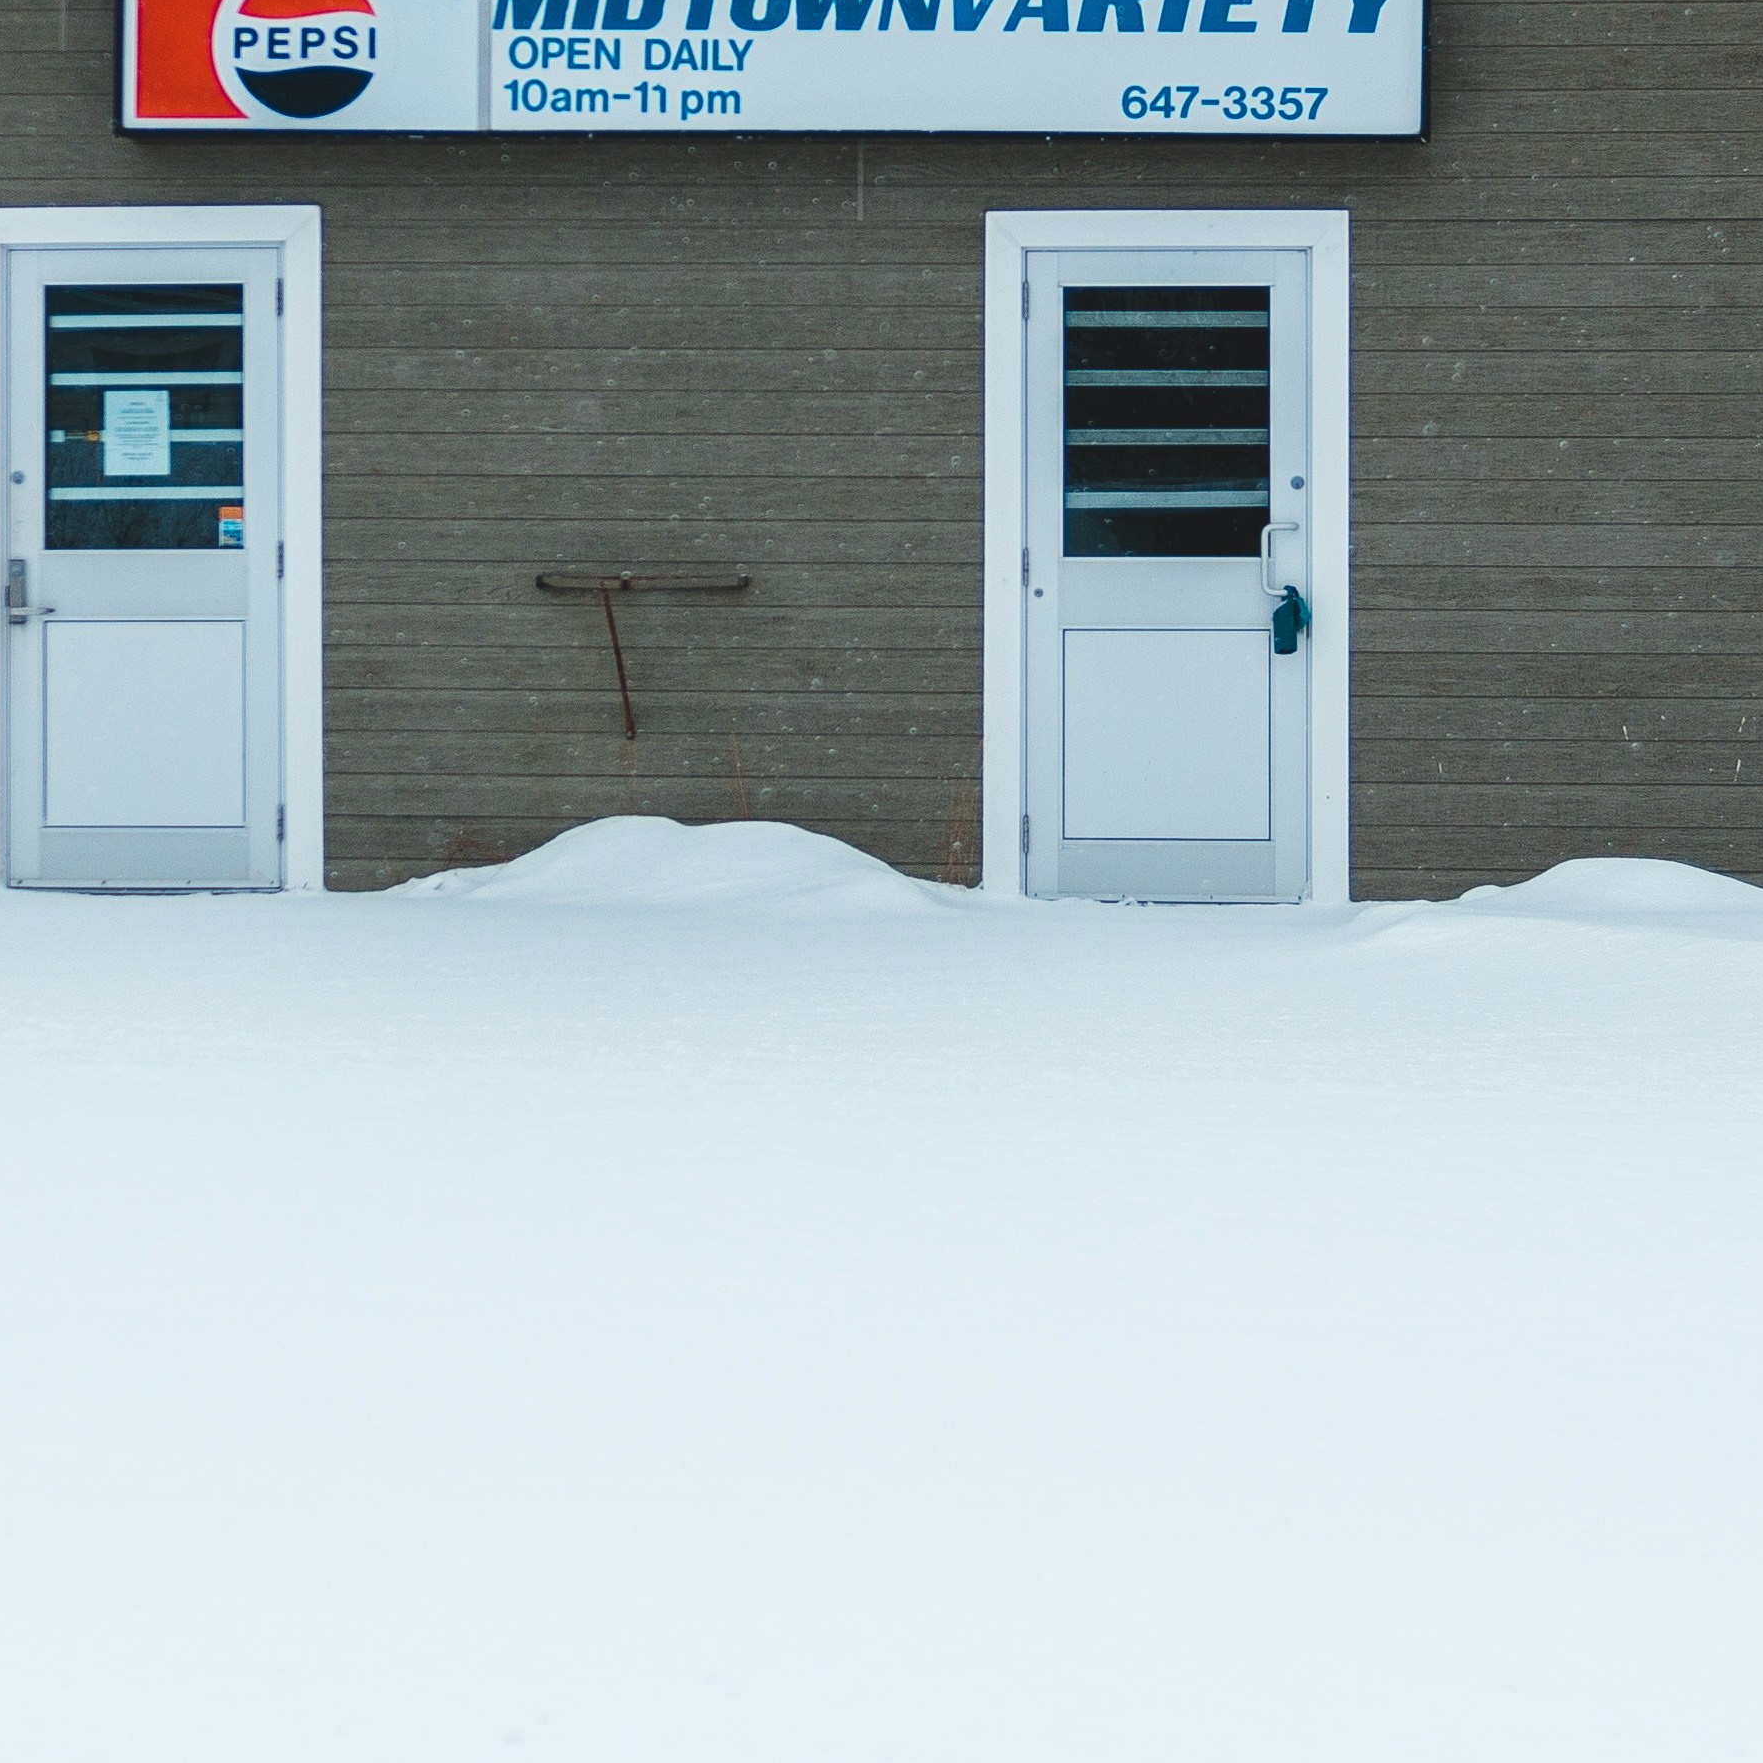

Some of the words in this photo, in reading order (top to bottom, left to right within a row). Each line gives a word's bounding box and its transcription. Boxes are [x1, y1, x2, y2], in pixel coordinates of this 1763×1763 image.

[233, 26, 377, 60] PEPSI
[508, 37, 621, 71] OPEN
[644, 38, 754, 72] DAILY
[1121, 84, 1329, 121] 647-3357
